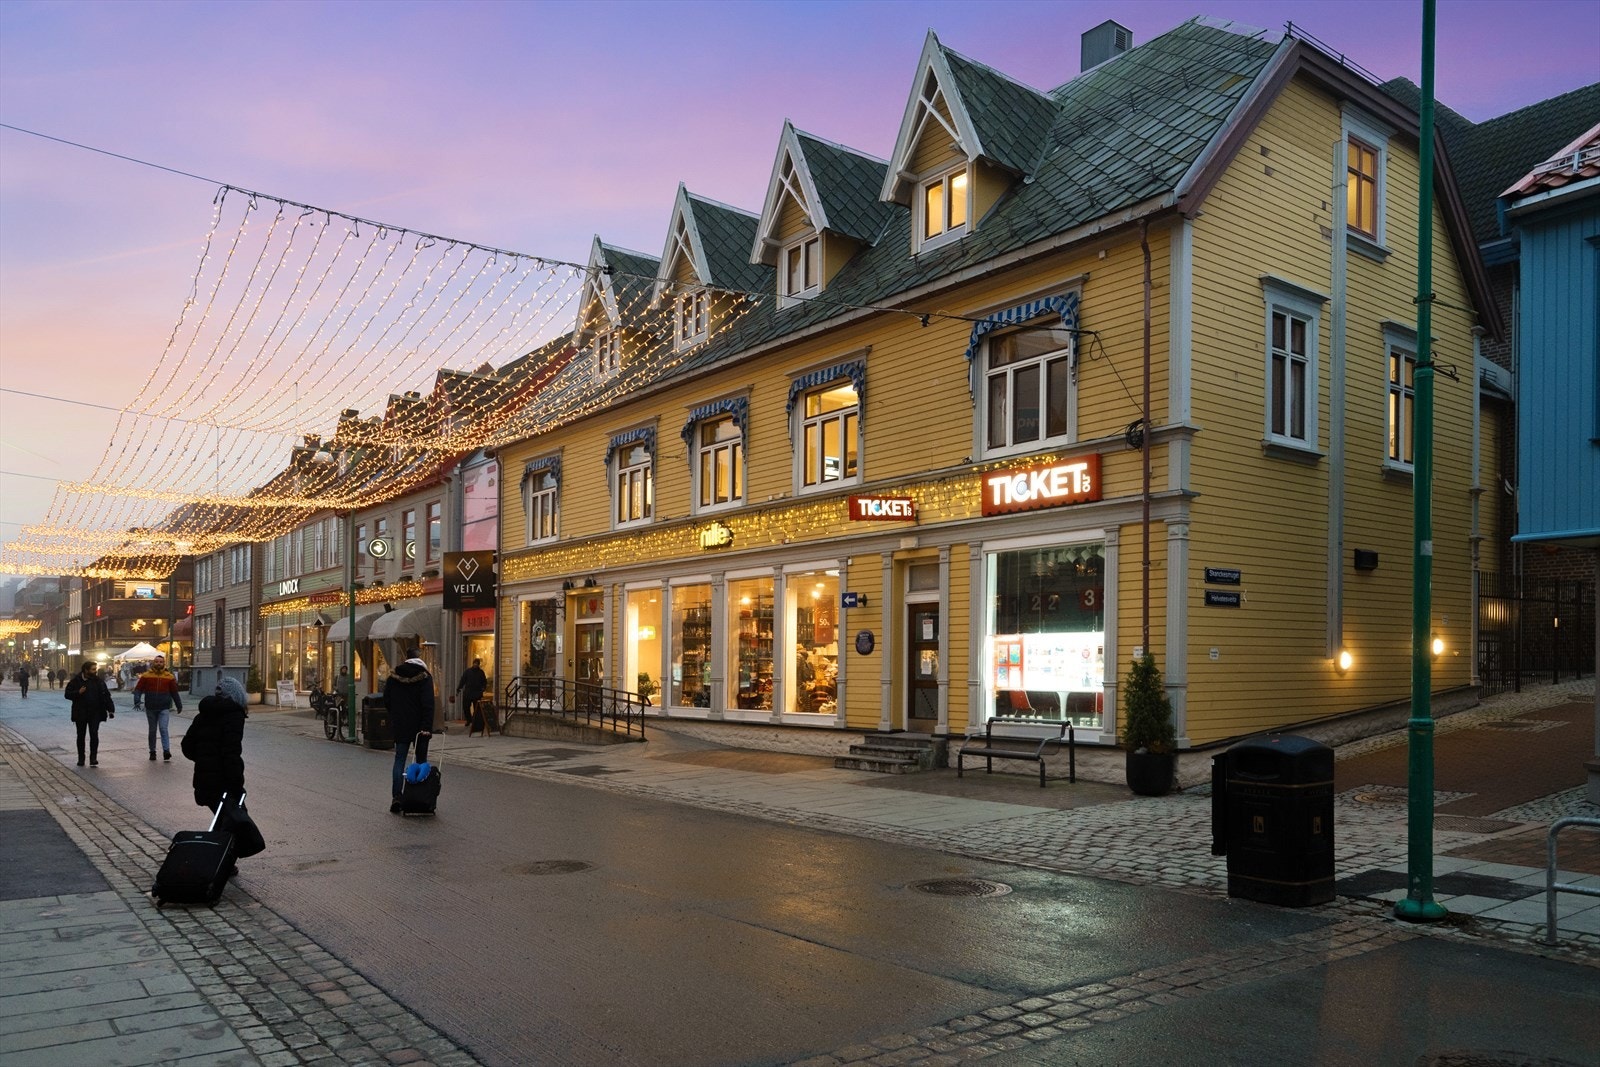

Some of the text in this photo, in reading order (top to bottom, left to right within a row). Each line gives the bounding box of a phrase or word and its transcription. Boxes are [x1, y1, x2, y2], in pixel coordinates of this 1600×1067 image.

[988, 462, 1088, 506] TICKET
[857, 498, 910, 516] TICKET
[453, 583, 483, 594] VEITA
[1084, 589, 1095, 606] 3
